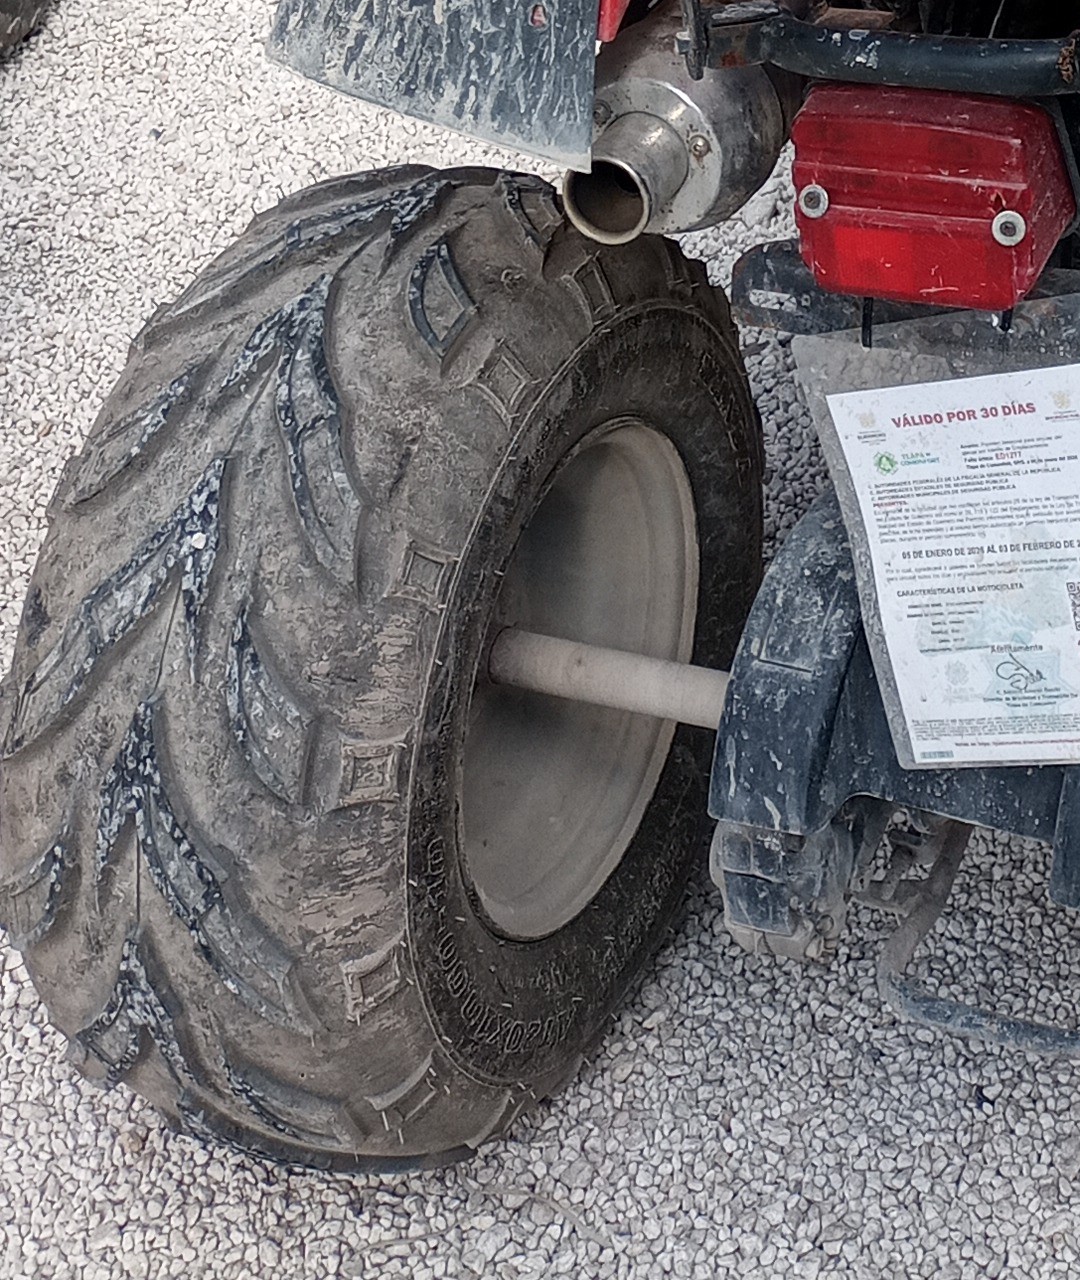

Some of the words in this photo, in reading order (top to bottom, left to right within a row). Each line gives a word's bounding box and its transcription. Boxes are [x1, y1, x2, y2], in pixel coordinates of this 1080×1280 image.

[891, 413, 943, 428] VÁLIDO
[946, 408, 977, 423] POR
[980, 405, 998, 419] 30
[1002, 400, 1036, 416] DÍAS
[913, 550, 923, 559] DE
[925, 548, 953, 558] ENERO
[954, 547, 966, 556] DE
[986, 544, 997, 554] AL
[1010, 543, 1021, 552] DE
[1022, 541, 1062, 551] FEBRERO
[1063, 540, 1075, 549] DE
